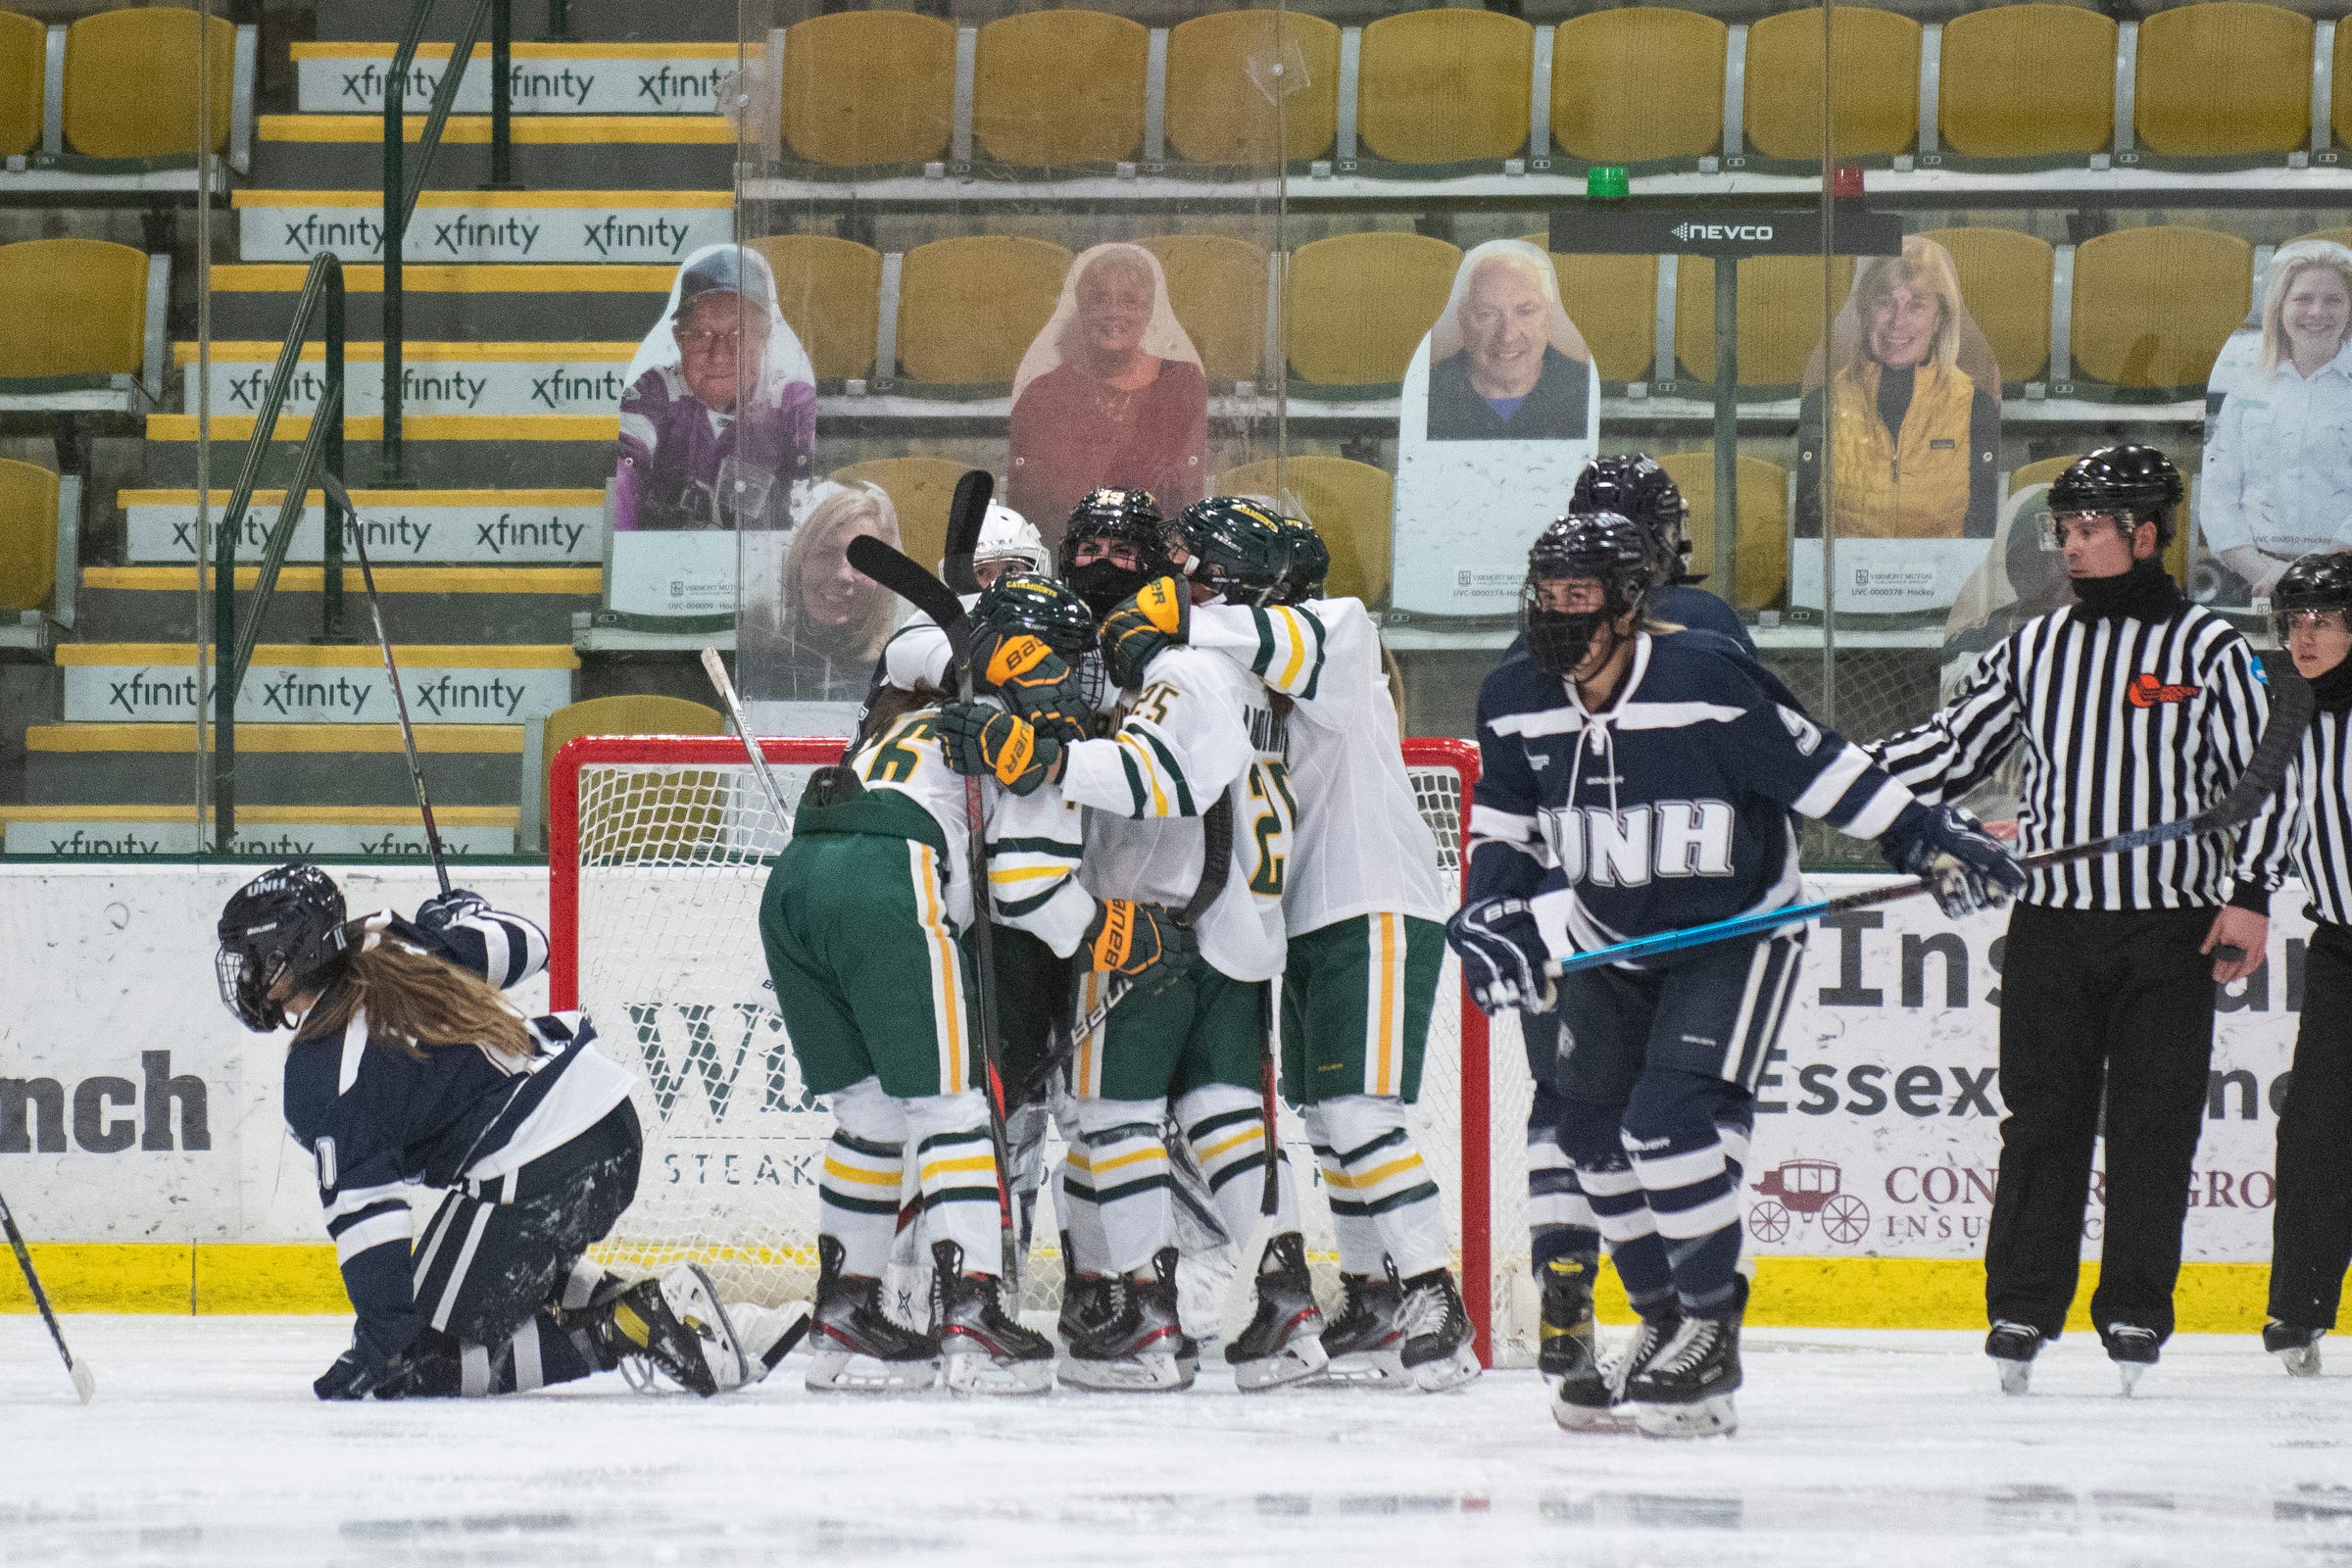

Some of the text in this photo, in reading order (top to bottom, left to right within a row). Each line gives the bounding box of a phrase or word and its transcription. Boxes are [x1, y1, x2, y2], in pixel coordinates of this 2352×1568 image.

[491, 65, 595, 105] finity
[639, 65, 730, 105] xfinit
[435, 215, 540, 255] xfinity
[584, 215, 689, 255] xfinity
[380, 369, 487, 409] finity
[531, 369, 624, 409] xfinit
[476, 514, 585, 554] xfinity
[110, 673, 525, 716] xfinit xfinity xfinity
[1537, 798, 1736, 888] UNH
[0, 1051, 211, 1153] nch
